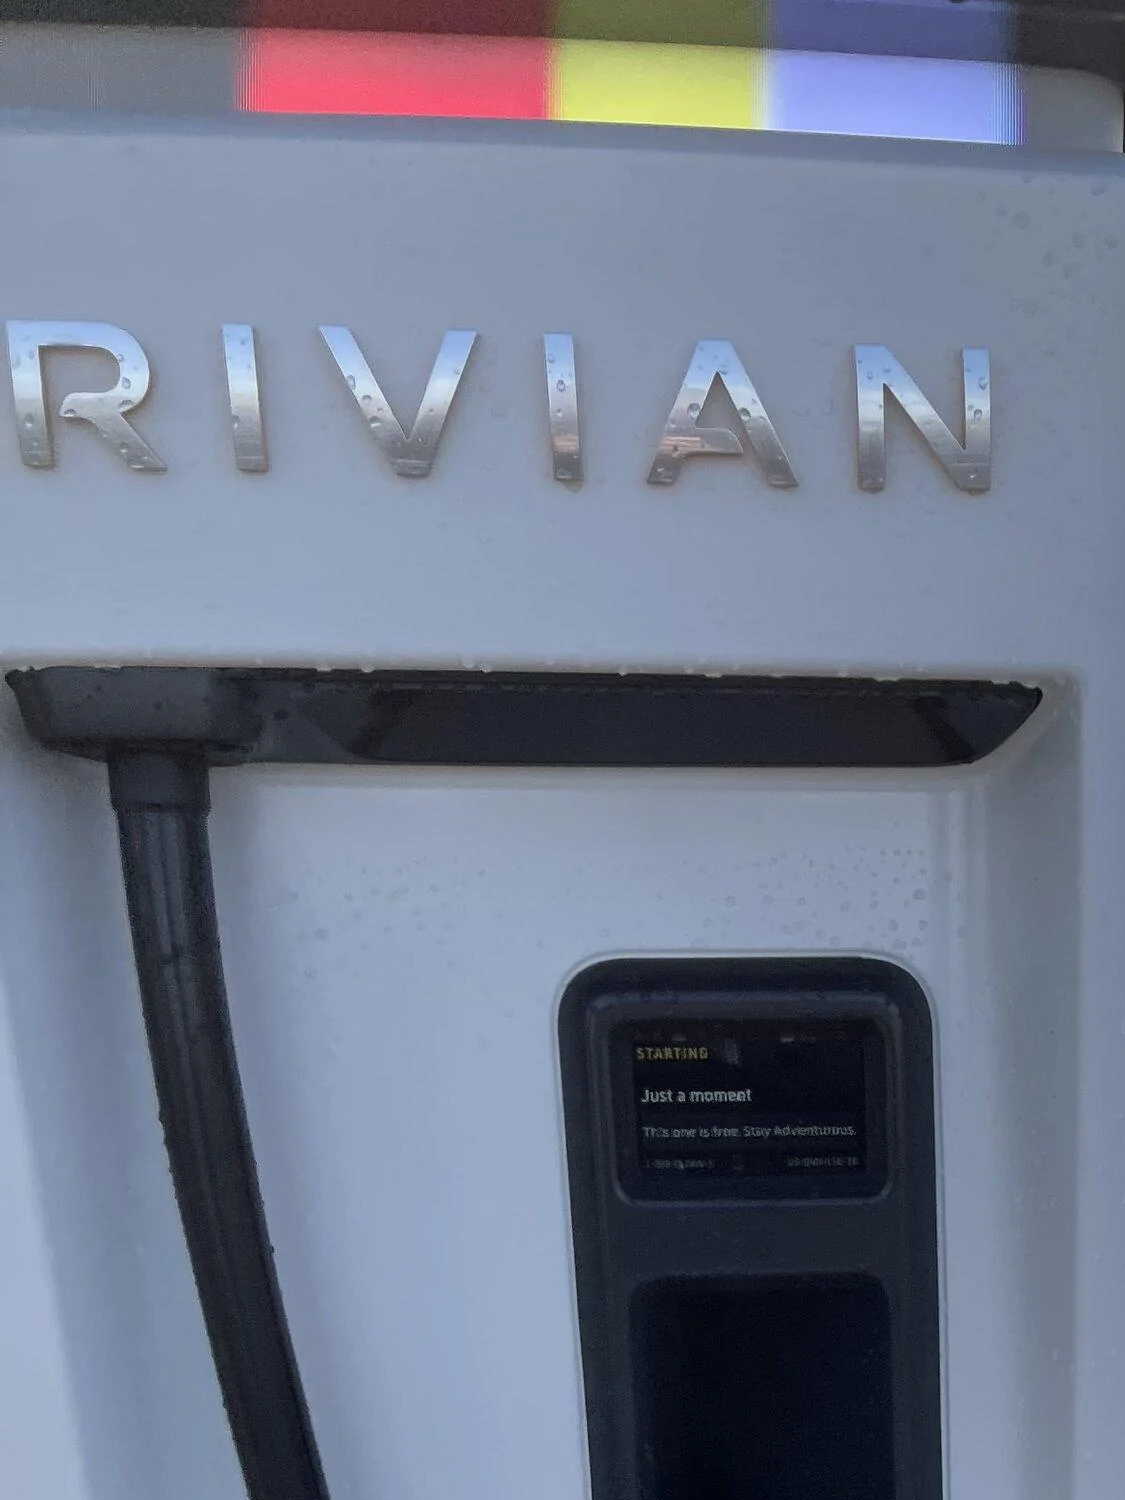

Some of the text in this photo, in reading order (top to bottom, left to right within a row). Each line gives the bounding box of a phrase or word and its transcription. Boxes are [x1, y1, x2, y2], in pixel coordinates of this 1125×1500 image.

[5, 318, 992, 494] RIVIAN
[636, 1046, 708, 1060] STARTING
[641, 1087, 753, 1103] Just a moment
[642, 1126, 670, 1139] This
[671, 1127, 697, 1139] one
[698, 1126, 711, 1138] is
